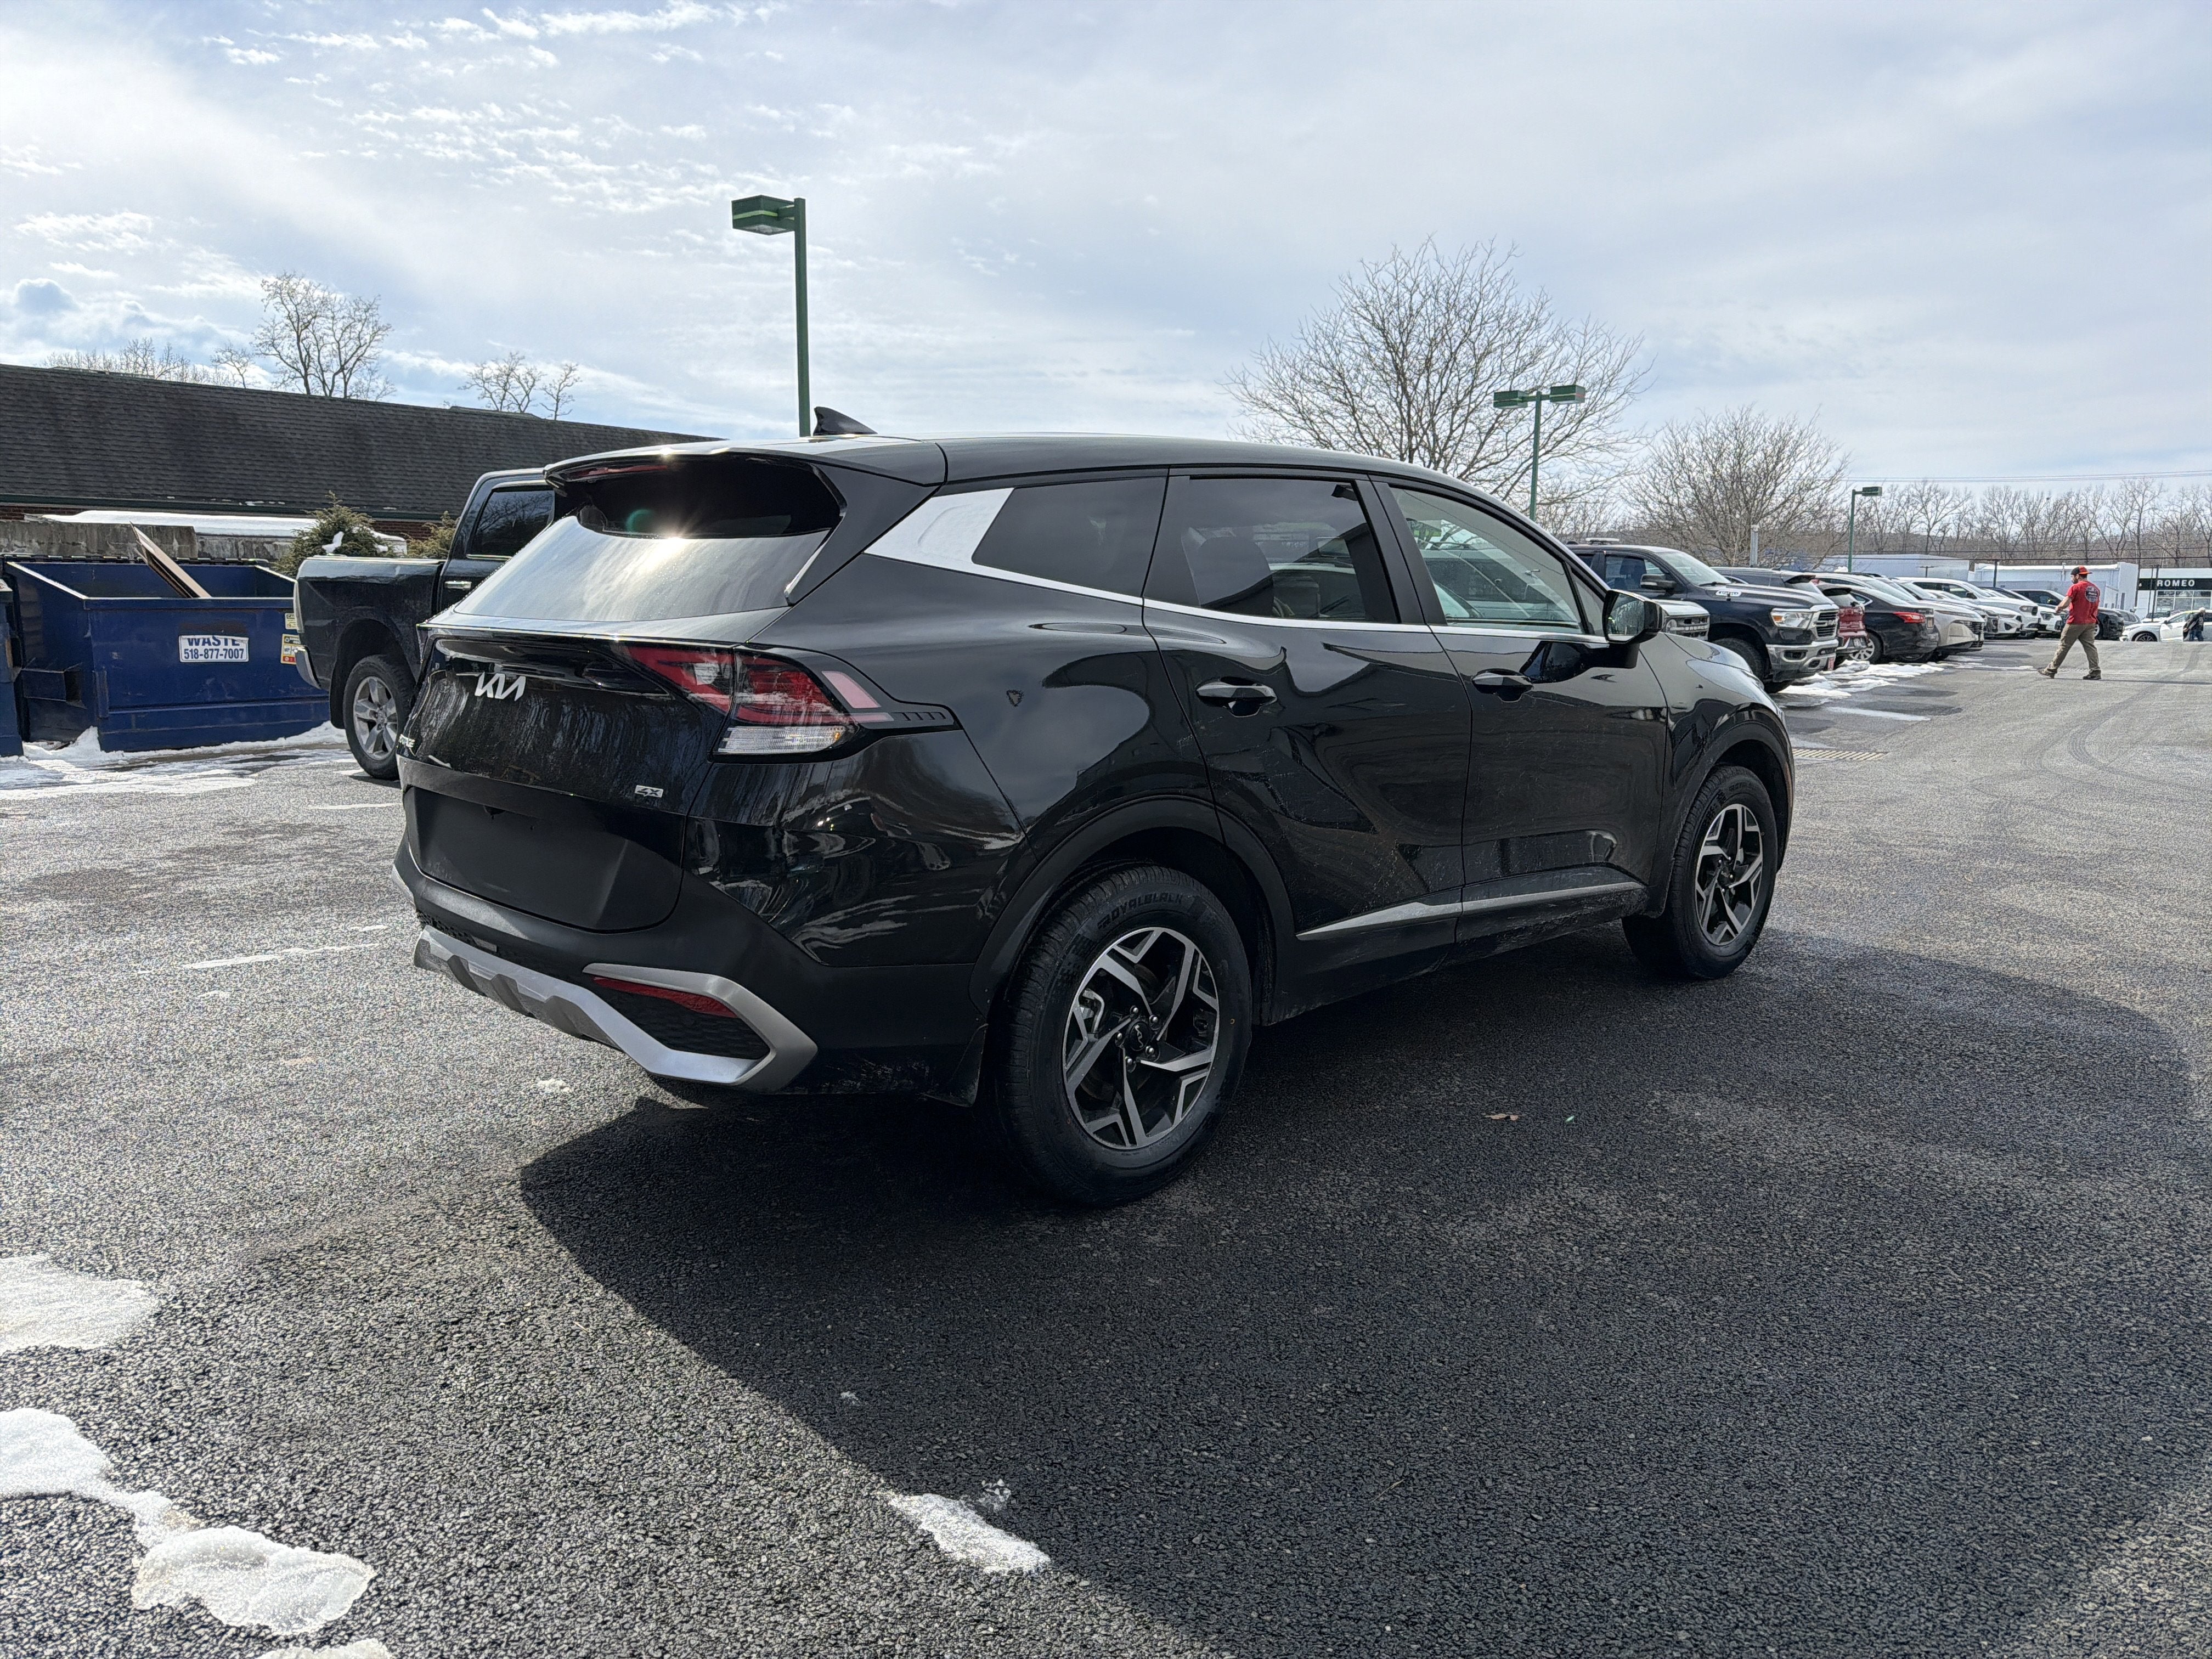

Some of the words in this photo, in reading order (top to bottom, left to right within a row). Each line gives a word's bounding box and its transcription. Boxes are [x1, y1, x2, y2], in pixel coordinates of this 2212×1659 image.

[187, 636, 240, 646] WASTE
[184, 648, 244, 659] 518-877-7007
[475, 672, 526, 701] KIA
